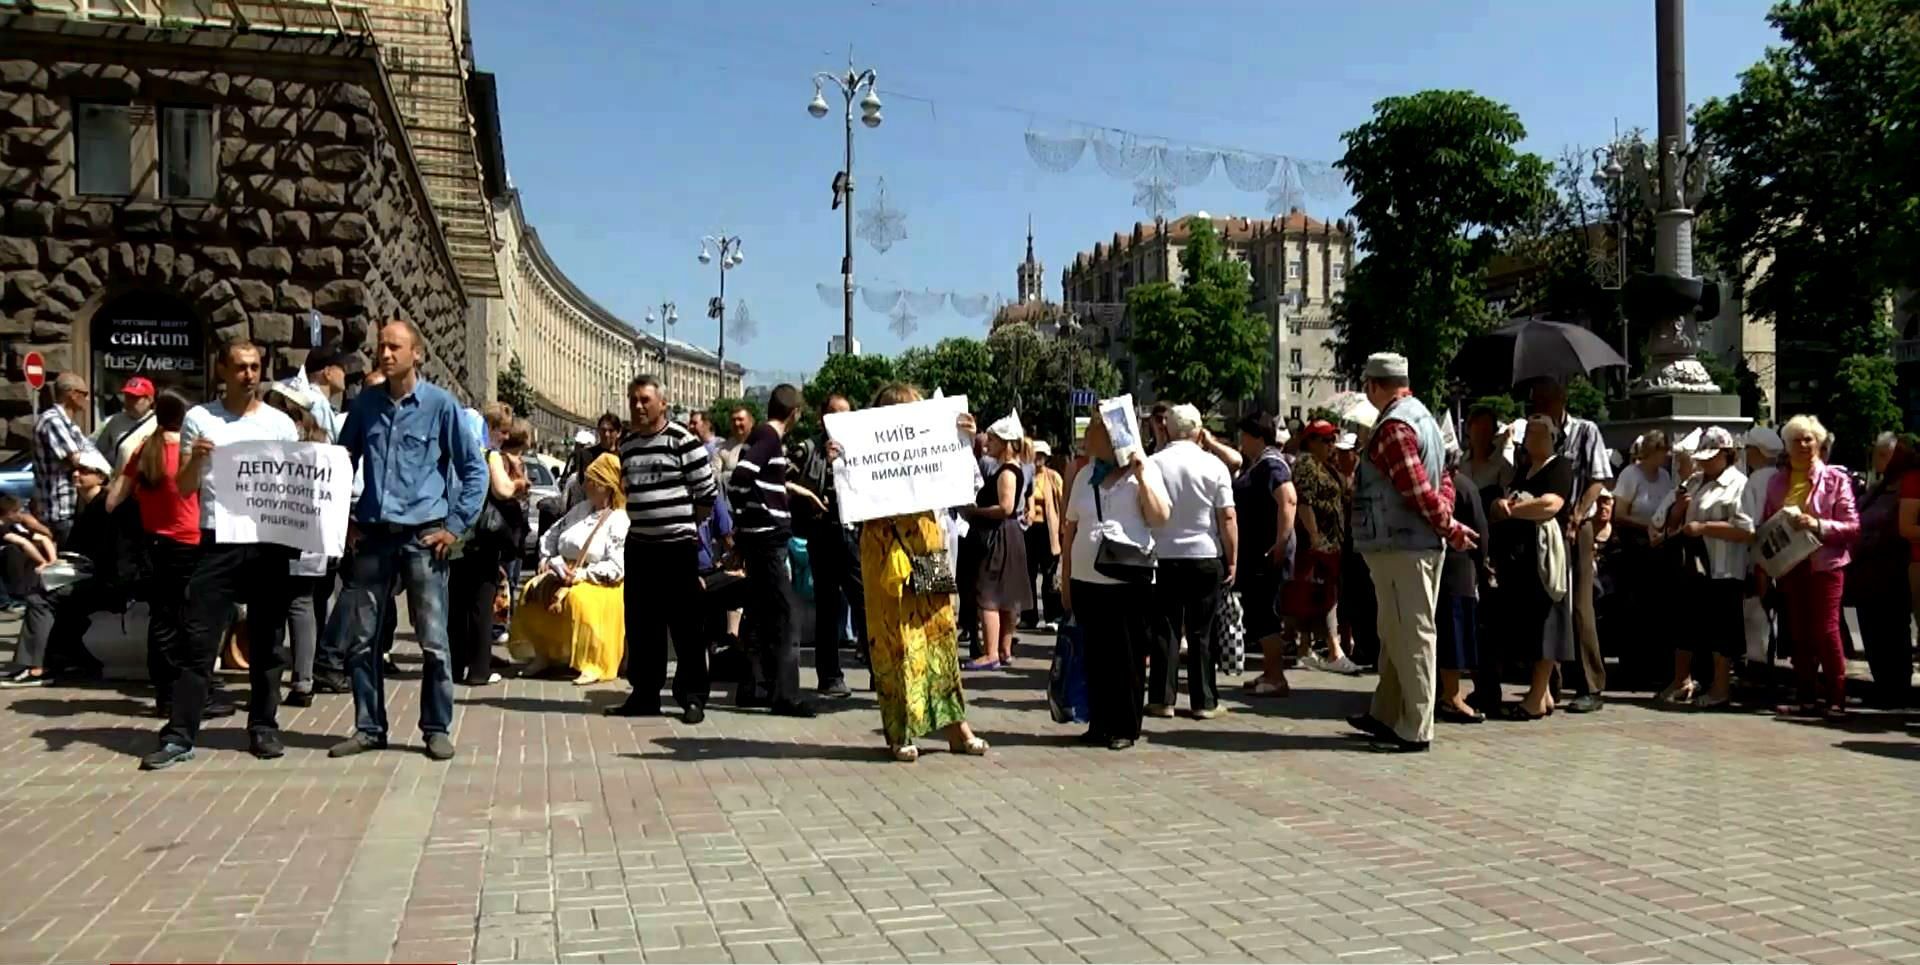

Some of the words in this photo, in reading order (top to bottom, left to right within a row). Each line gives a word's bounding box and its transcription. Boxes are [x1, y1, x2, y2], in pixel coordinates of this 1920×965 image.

[110, 330, 189, 346] centrum
[874, 424, 916, 444] КИЇВ
[844, 457, 860, 467] НЕ
[862, 451, 900, 465] МІСТО
[903, 447, 928, 461] ДЛЯ
[237, 461, 332, 483] ДЕПУТАТИ!
[871, 460, 943, 480] ВИМАГАЧІВ!
[235, 482, 250, 492] НЕ
[254, 482, 315, 500] ГОЛОСУЙТЕ
[319, 491, 332, 501] ЗА
